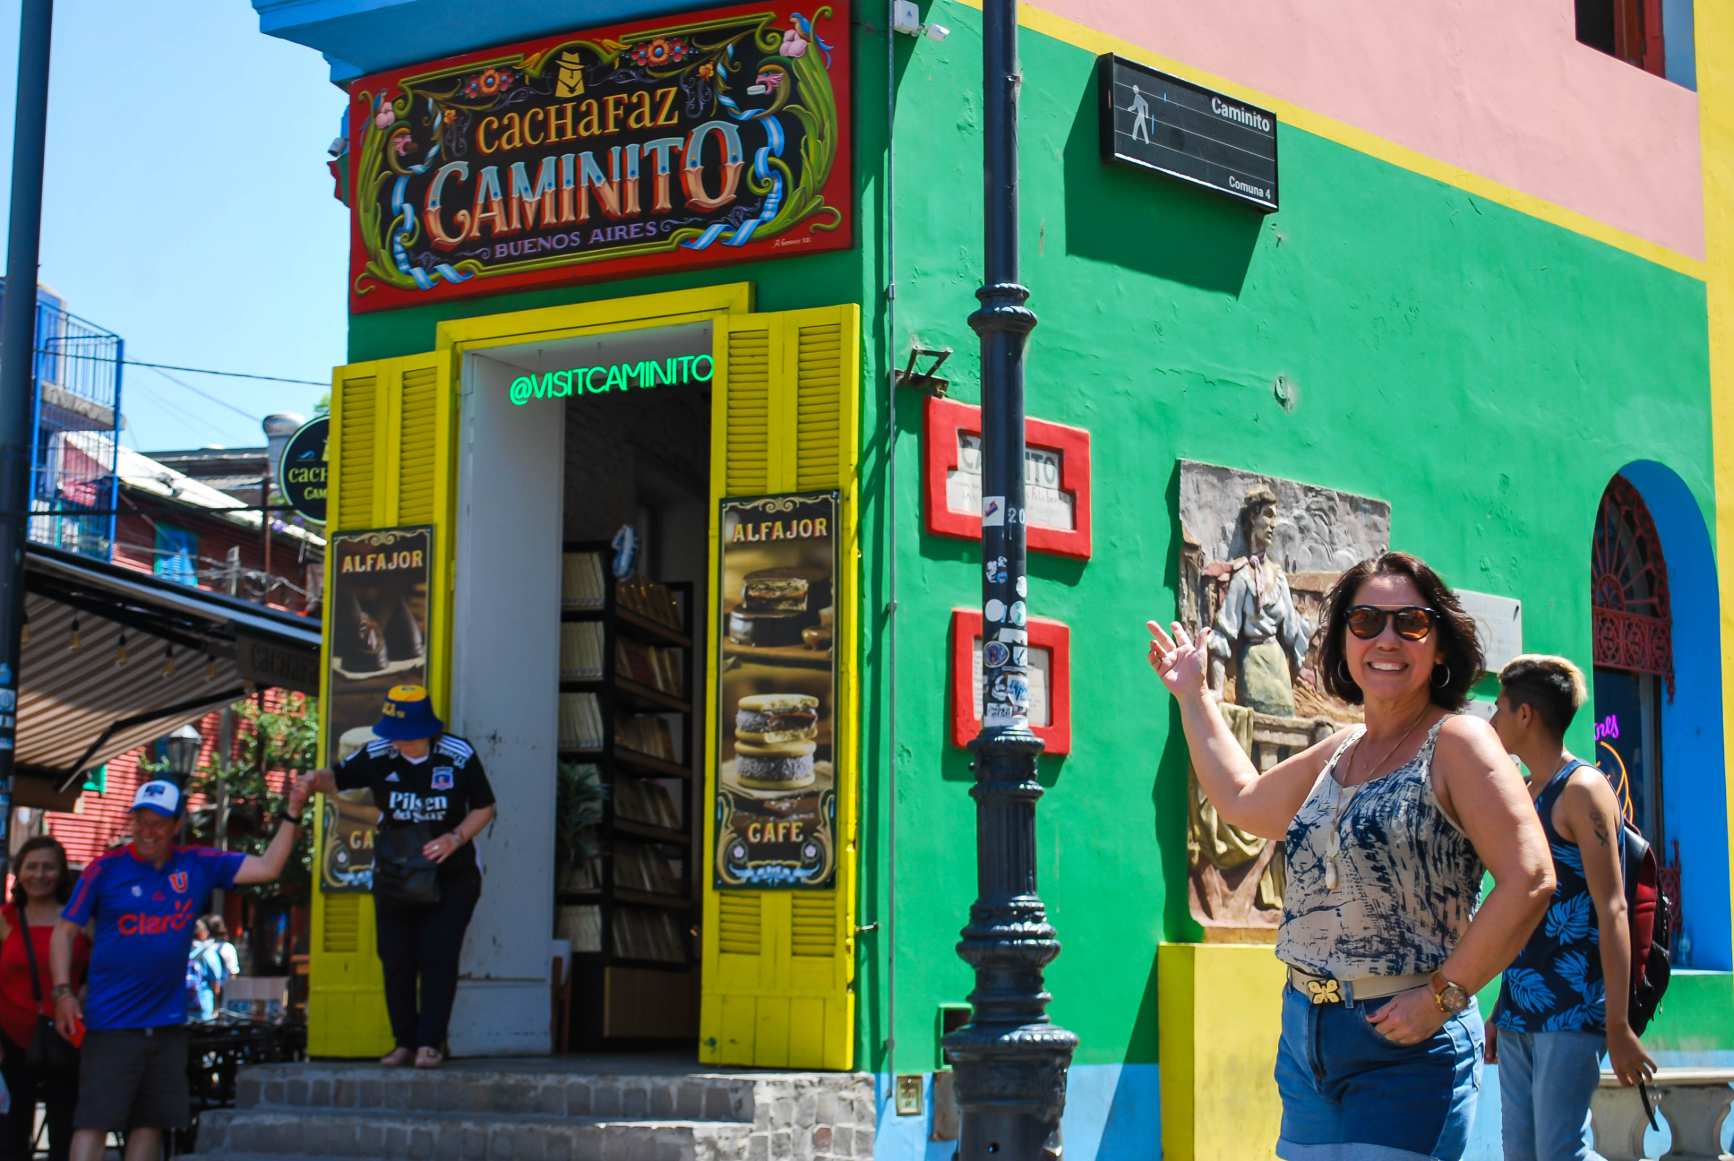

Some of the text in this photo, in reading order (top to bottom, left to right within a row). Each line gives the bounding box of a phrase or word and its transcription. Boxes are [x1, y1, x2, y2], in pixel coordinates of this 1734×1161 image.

[1211, 97, 1270, 132] Caminito
[424, 120, 745, 250] CAMINITO
[1228, 175, 1272, 200] Comuna 4
[494, 221, 658, 259] BUENOS AIRES
[510, 354, 715, 406] @VISITCAMINITO
[960, 434, 1058, 486] CITO
[734, 517, 828, 544] ALFAJOR
[341, 549, 423, 574] ALFAJOR
[349, 829, 380, 850] CA
[118, 908, 193, 936] Claro
